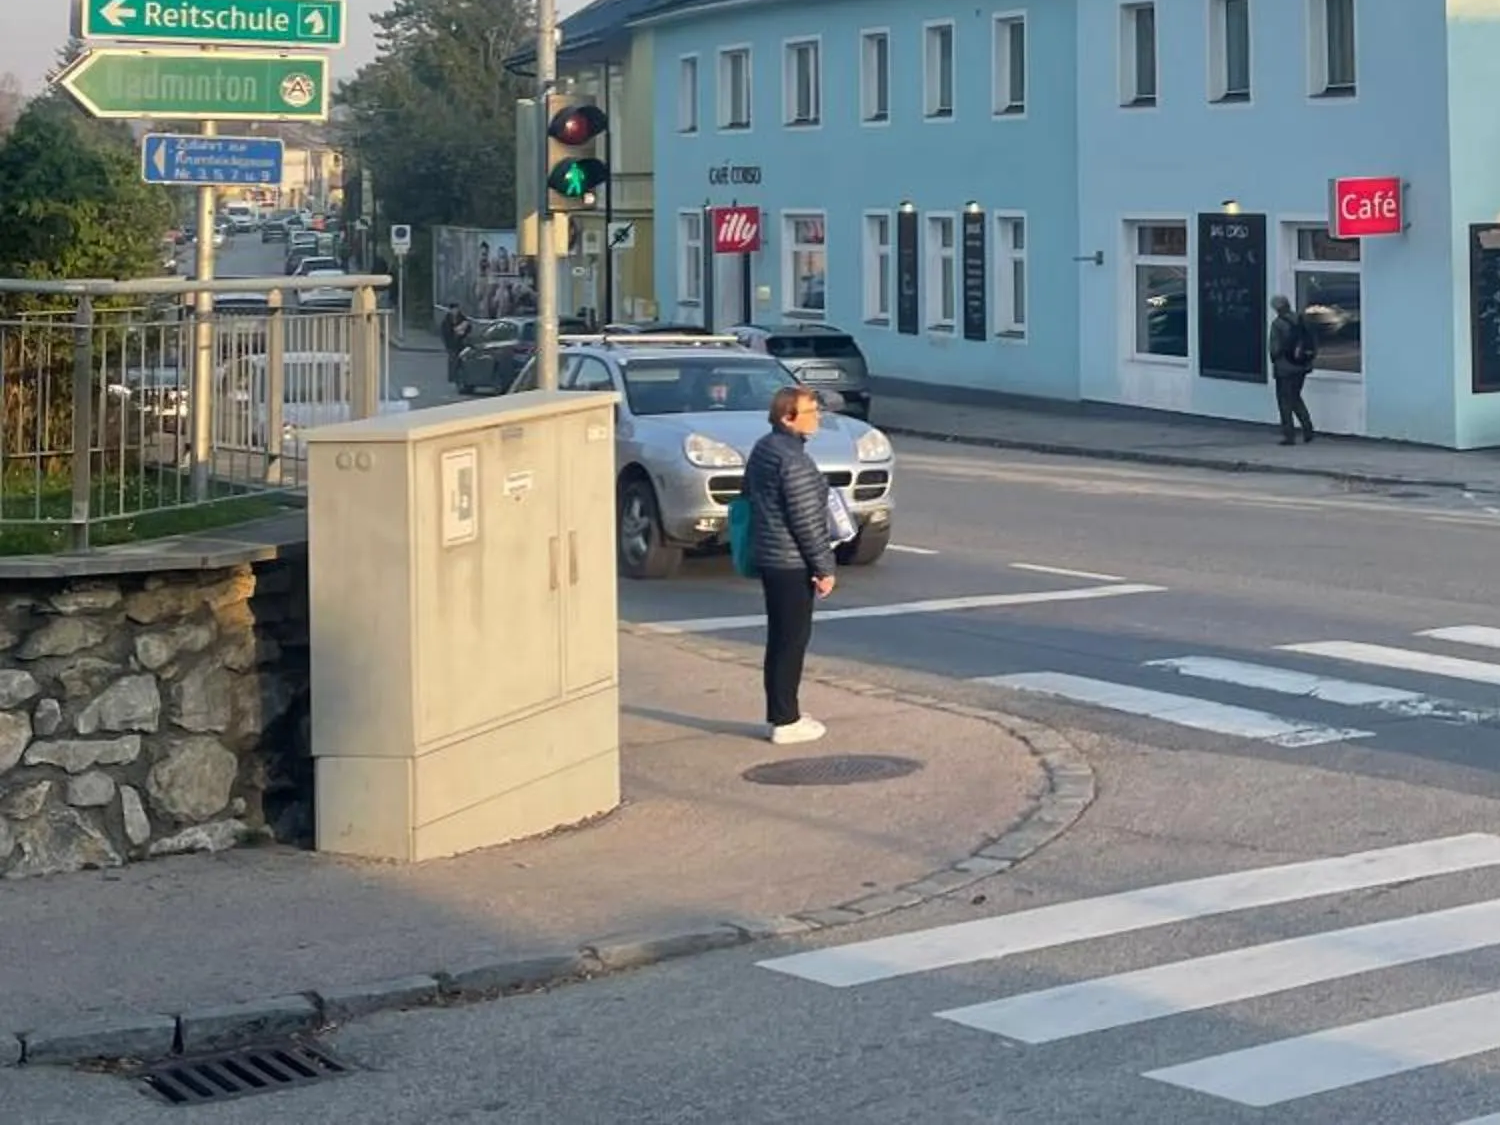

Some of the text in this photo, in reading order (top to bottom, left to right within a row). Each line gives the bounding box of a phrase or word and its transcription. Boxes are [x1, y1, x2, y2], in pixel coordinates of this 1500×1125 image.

[145, 2, 290, 33] Reitschule
[1341, 191, 1397, 220] Café
[718, 213, 758, 248] illy
